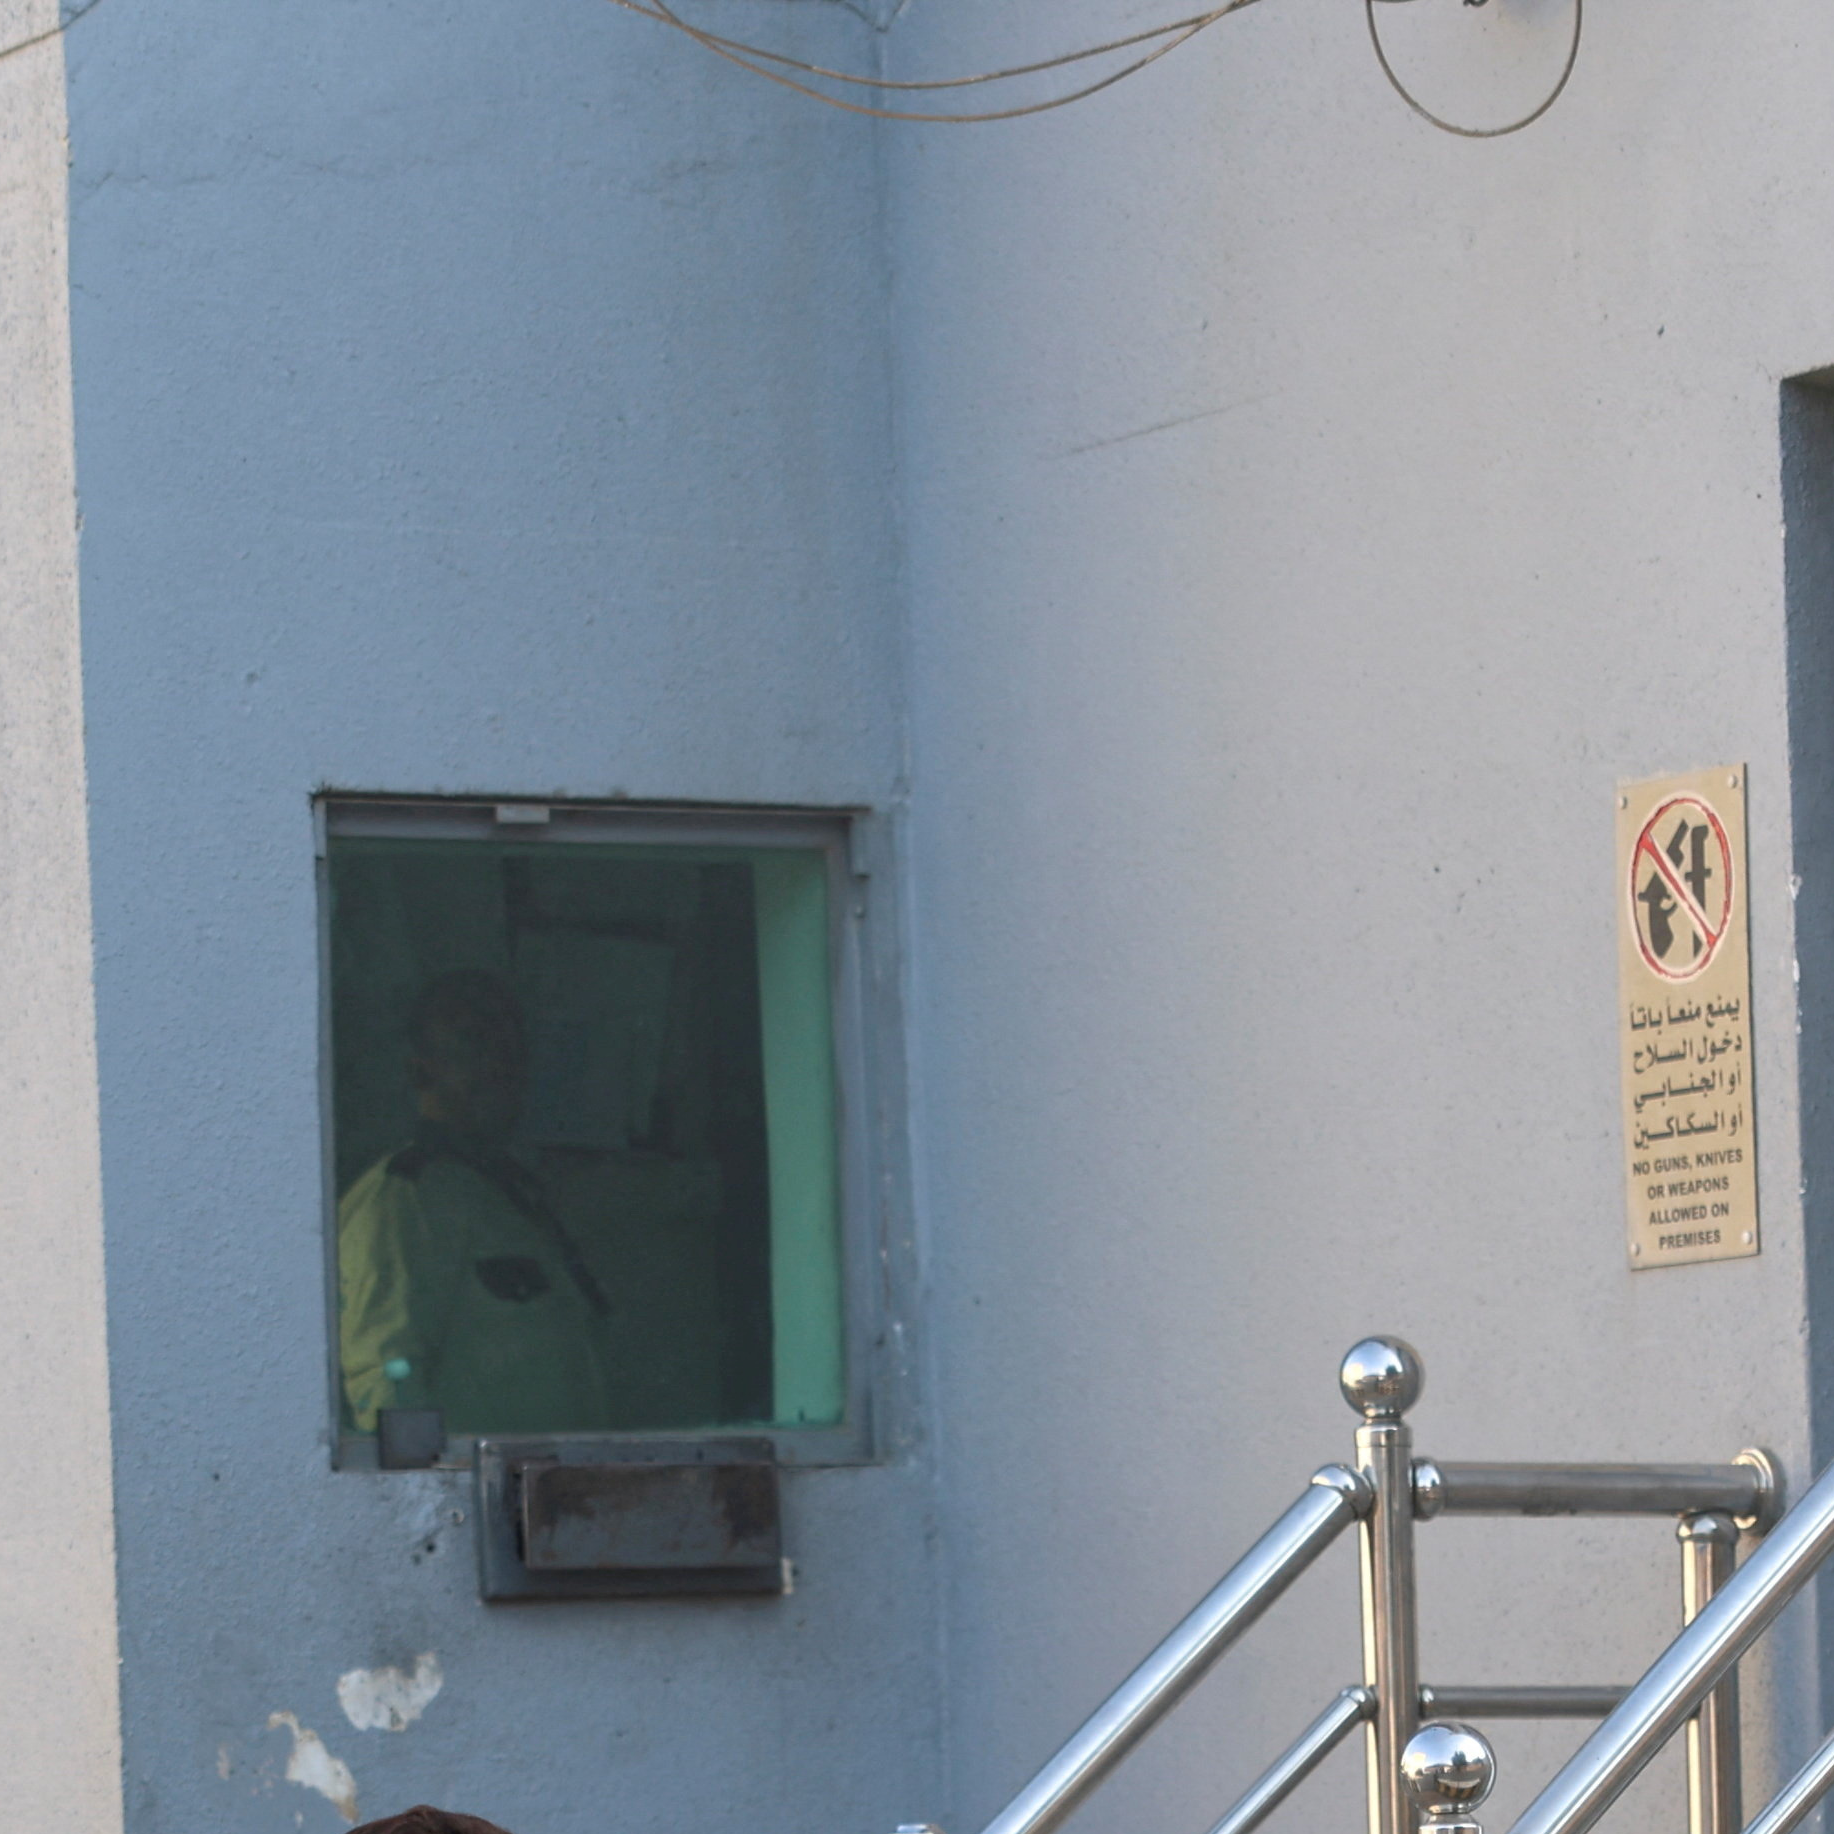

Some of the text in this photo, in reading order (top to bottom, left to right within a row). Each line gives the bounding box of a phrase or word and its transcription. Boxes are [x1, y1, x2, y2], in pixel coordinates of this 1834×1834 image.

[1706, 994, 1740, 1028] يمنع
[1634, 1031, 1742, 1073] دخول السلاح
[1634, 1061, 1742, 1113] أو الجنابي
[1634, 1102, 1743, 1149] أو السكاكين
[1632, 1148, 1743, 1176] NO GUNS, KNIVES
[1647, 1176, 1730, 1200] OR WEAPONS
[1649, 1202, 1730, 1226] ALLOWED ON
[1658, 1229, 1721, 1250] PREMISES
